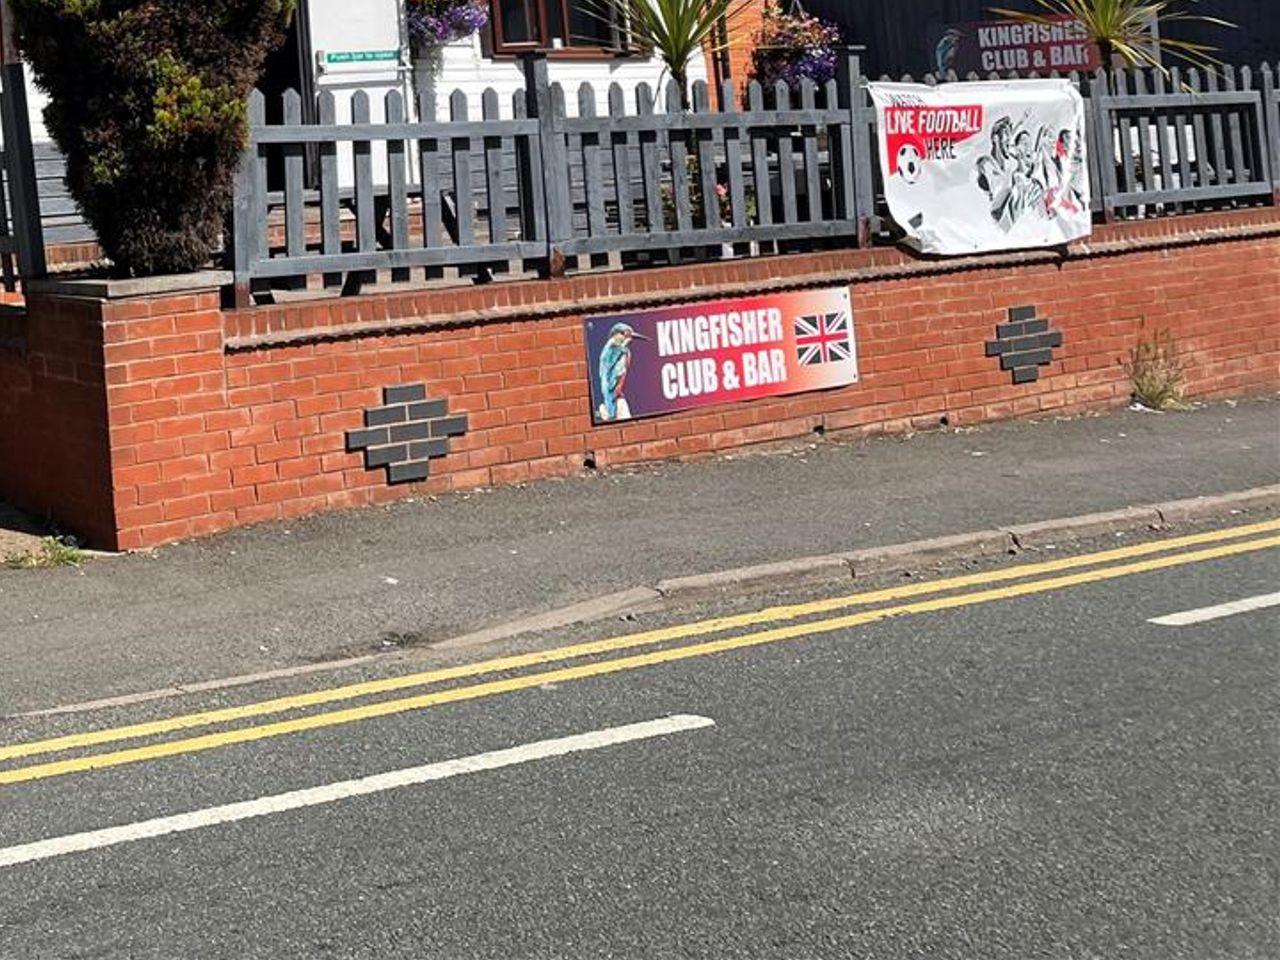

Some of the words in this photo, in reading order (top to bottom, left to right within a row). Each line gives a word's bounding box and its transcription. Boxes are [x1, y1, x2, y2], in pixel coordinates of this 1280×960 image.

[980, 47, 1029, 71] CLUB
[1032, 49, 1047, 67] &
[885, 109, 916, 135] LIVE
[917, 108, 980, 134] FOOTBALL
[924, 137, 957, 160] HERE
[656, 307, 783, 356] KINGFISHER
[661, 357, 719, 400] CLUB
[722, 360, 741, 388] &
[742, 349, 787, 387] BAR
